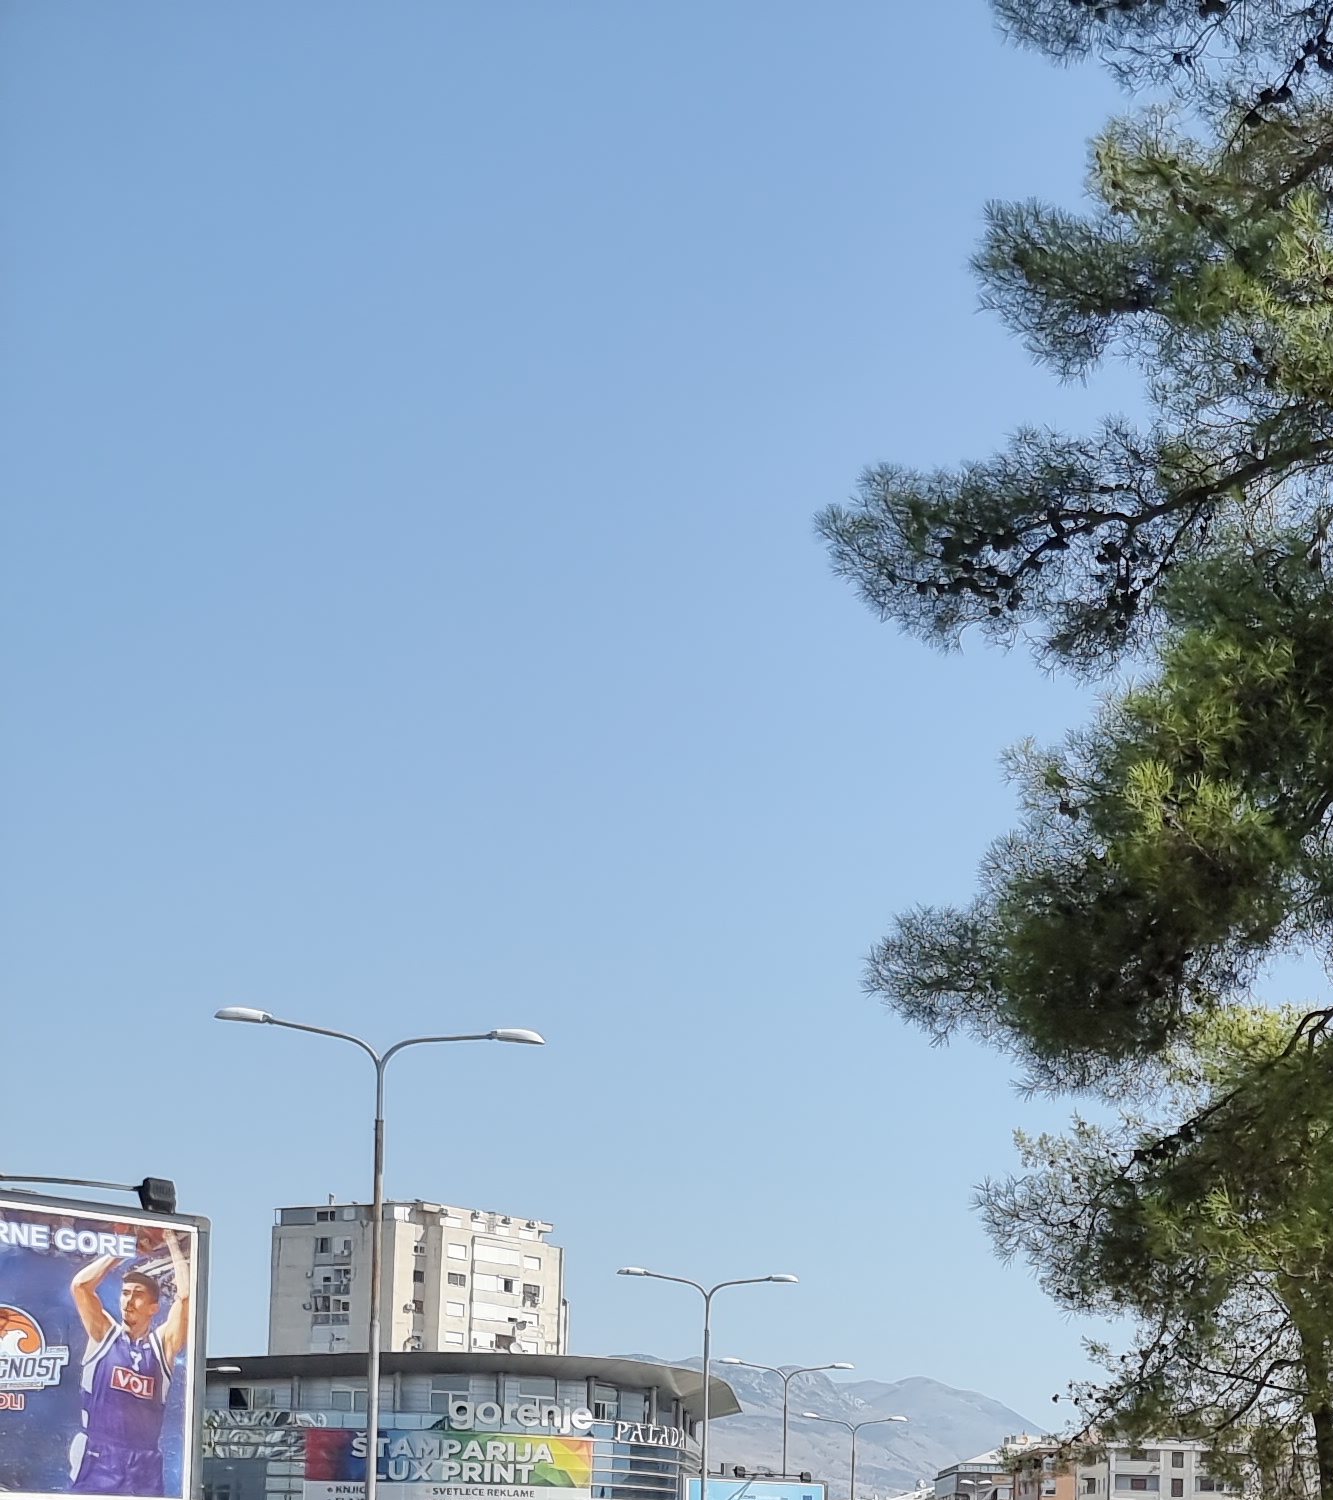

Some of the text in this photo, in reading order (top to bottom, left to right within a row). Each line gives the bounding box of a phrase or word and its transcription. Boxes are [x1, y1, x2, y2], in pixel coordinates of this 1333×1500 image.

[55, 1229, 137, 1258] GORE
[450, 1399, 593, 1434] gorenje
[351, 1431, 553, 1464] ŠTAMPARIJA
[441, 1462, 535, 1484] PRINT
[487, 1489, 535, 1498] REKLAME
